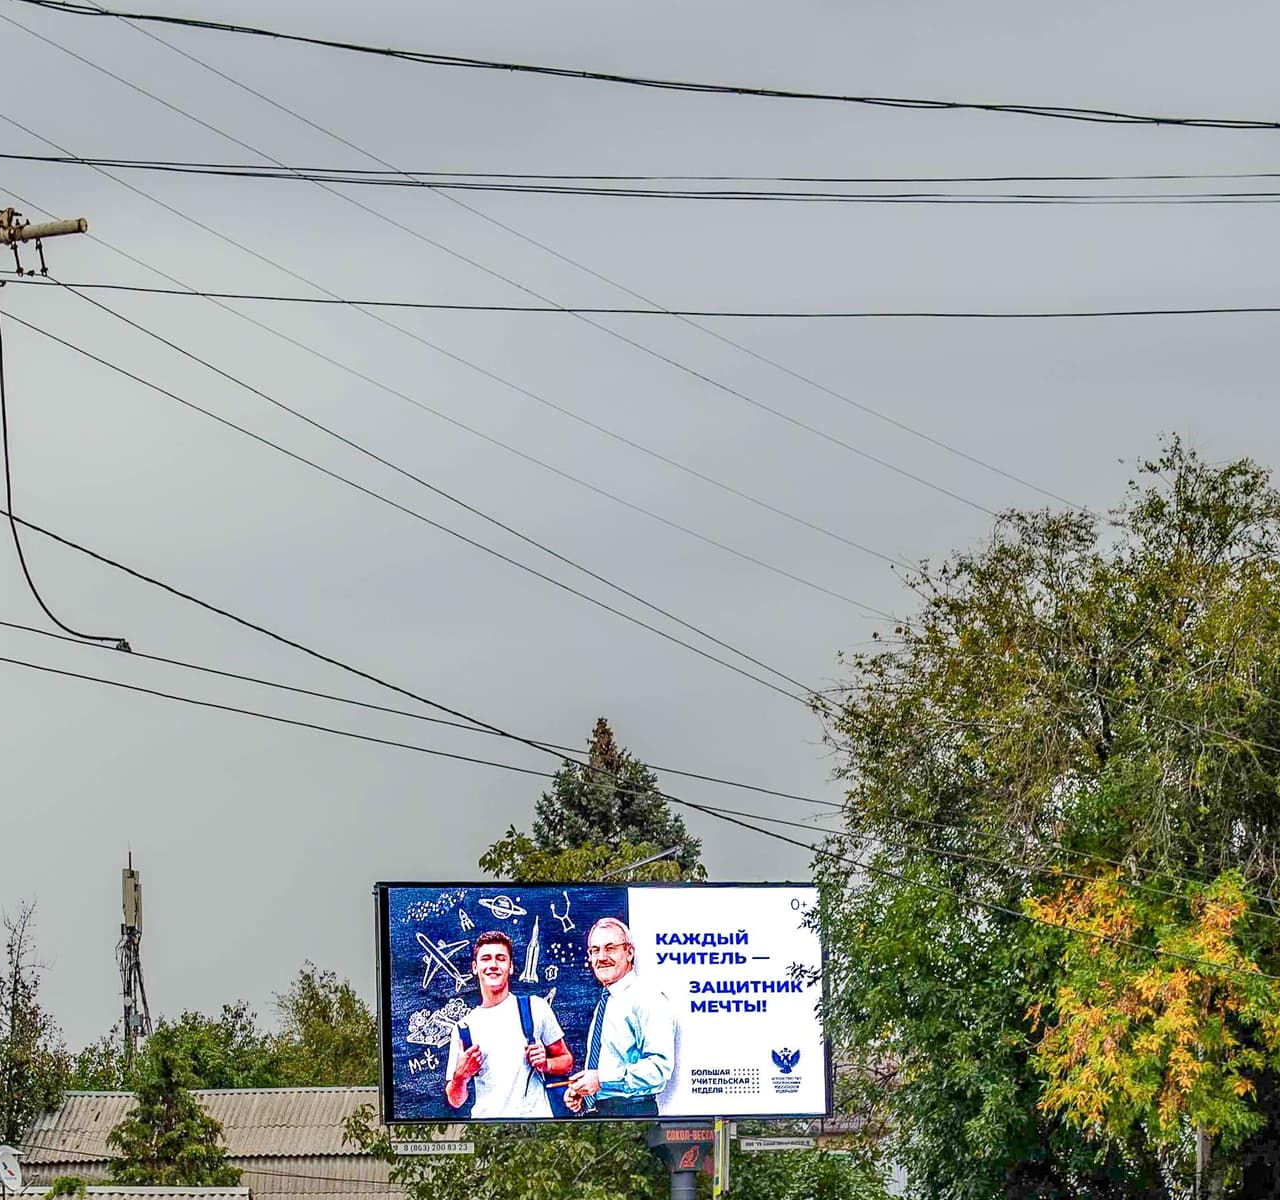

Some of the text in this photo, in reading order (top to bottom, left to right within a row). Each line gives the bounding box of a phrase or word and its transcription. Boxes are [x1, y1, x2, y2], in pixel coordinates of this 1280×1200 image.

[655, 929, 749, 947] КАЖДЫЙ
[656, 952, 747, 965] УЧИТЕЛЬ
[689, 980, 803, 995] ЗАЩИТНИК
[690, 1000, 767, 1013] МЕЧТЫ!
[432, 1144, 446, 1152] 200
[458, 1144, 468, 1152] 23
